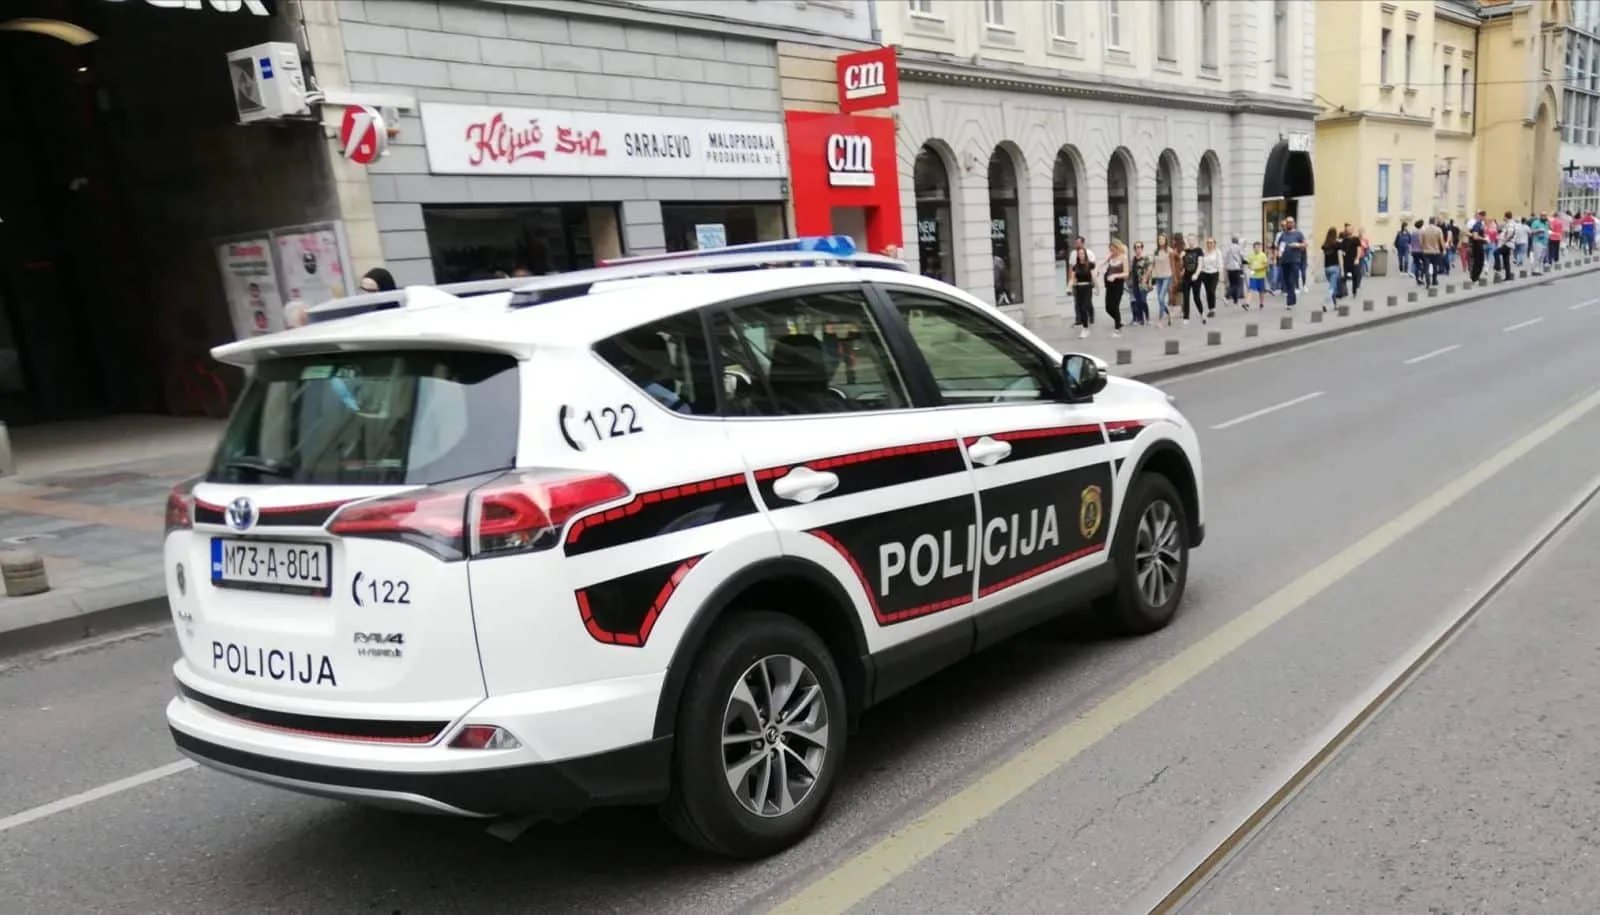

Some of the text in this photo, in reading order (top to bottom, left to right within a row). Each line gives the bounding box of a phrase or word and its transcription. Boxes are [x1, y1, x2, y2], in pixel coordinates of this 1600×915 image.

[844, 61, 884, 90] cm
[624, 132, 691, 159] SARAJEVO
[708, 132, 774, 150] MALOPRODAJA
[827, 134, 873, 172] cm
[583, 403, 643, 441] 122
[224, 546, 322, 582] M73-A-801
[879, 504, 1060, 597] POLICIJA
[368, 579, 411, 604] 122
[212, 640, 337, 687] POLICIJA
